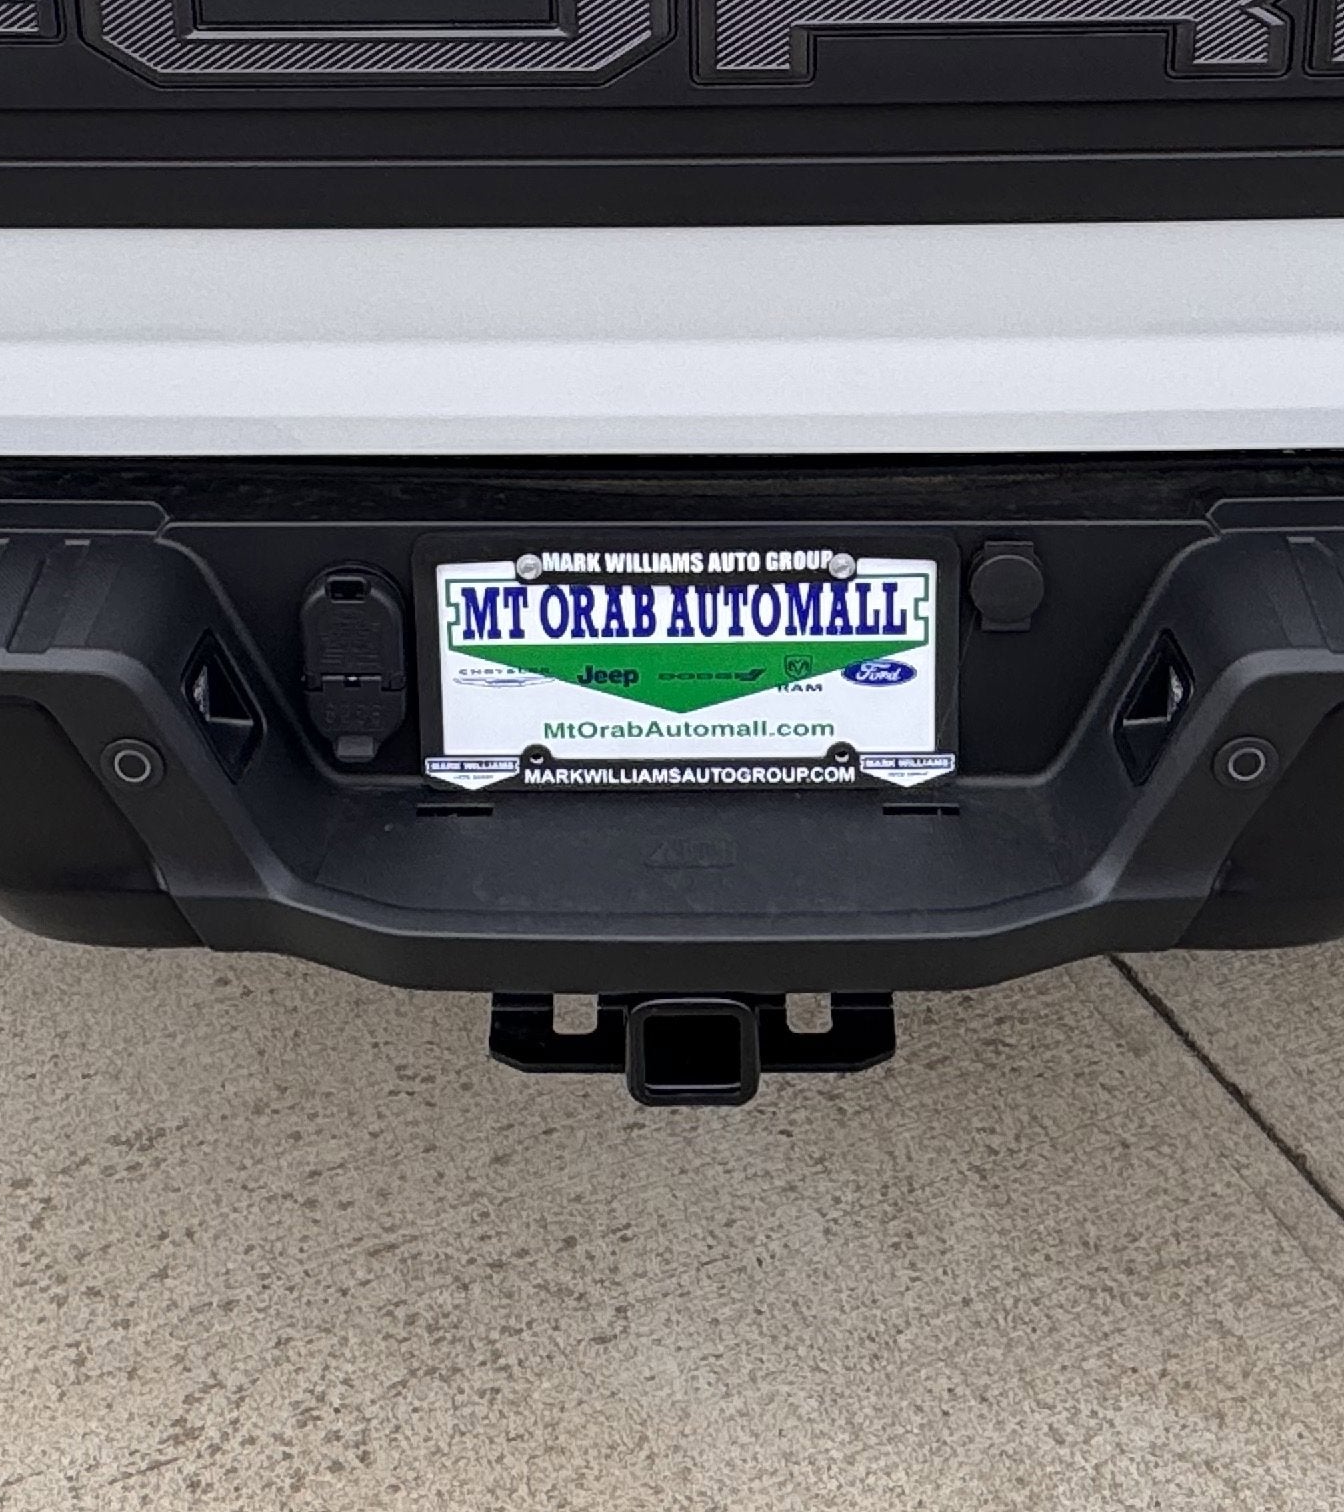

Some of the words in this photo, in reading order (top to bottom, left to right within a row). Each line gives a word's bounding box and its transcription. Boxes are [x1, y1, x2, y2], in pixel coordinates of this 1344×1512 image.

[542, 551, 601, 573] MARK
[604, 551, 704, 574] WILLIAMS
[708, 551, 760, 574] AUTO
[765, 550, 834, 571] GROUP
[461, 586, 528, 640] MT
[540, 584, 657, 639] ORAB
[666, 581, 908, 637] AUTOMALL
[577, 665, 640, 687] Jeep
[856, 661, 902, 682] Ford
[777, 683, 824, 693] RAM
[544, 719, 836, 739] MtOrabAutomall.com
[865, 758, 895, 768] MARK
[898, 758, 949, 767] WILLIAMS
[524, 766, 856, 785] MARKWILLIAMSAUTOGROUP.COM
